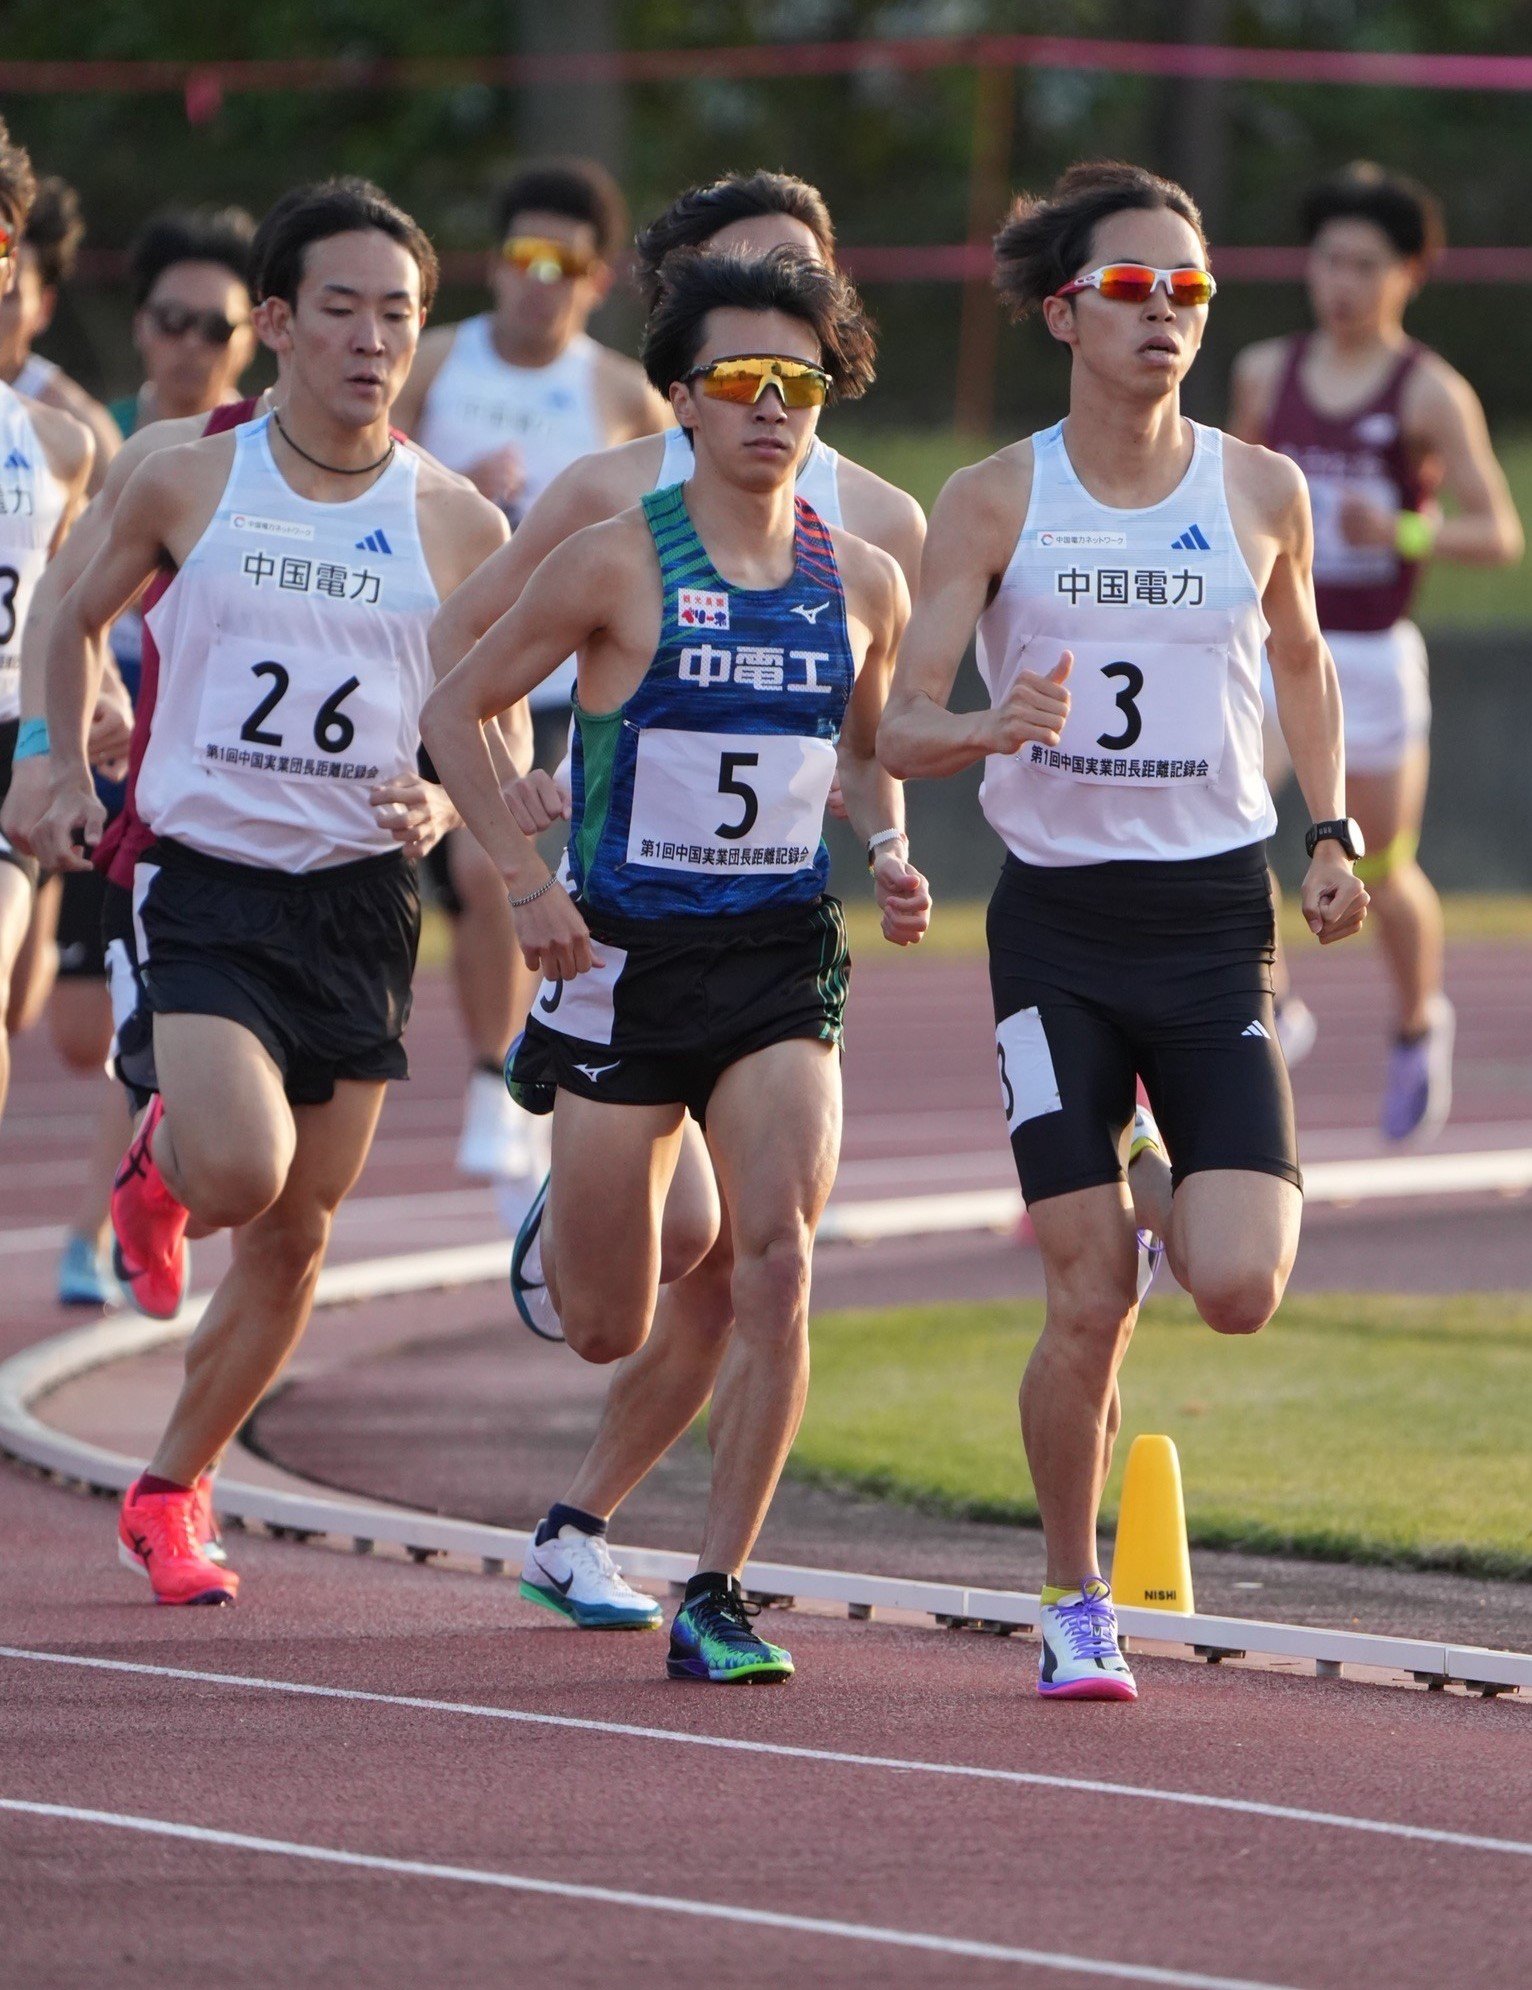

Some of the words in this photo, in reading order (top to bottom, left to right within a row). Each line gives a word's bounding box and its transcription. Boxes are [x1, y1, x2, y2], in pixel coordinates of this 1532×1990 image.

[243, 552, 381, 604] 中国電力
[1057, 567, 1204, 606] 中国電力
[678, 644, 832, 694] 中電工
[240, 660, 361, 754] 26
[1096, 661, 1144, 750] 3
[206, 743, 380, 779] 第1回中国実業団長距離記録会
[1030, 744, 1210, 778] 第1回中国実業団長距離記録会
[714, 751, 759, 840] 5
[641, 839, 810, 866] 第1回中国実業団長距離記録会
[1144, 1590, 1176, 1601] NISHI
